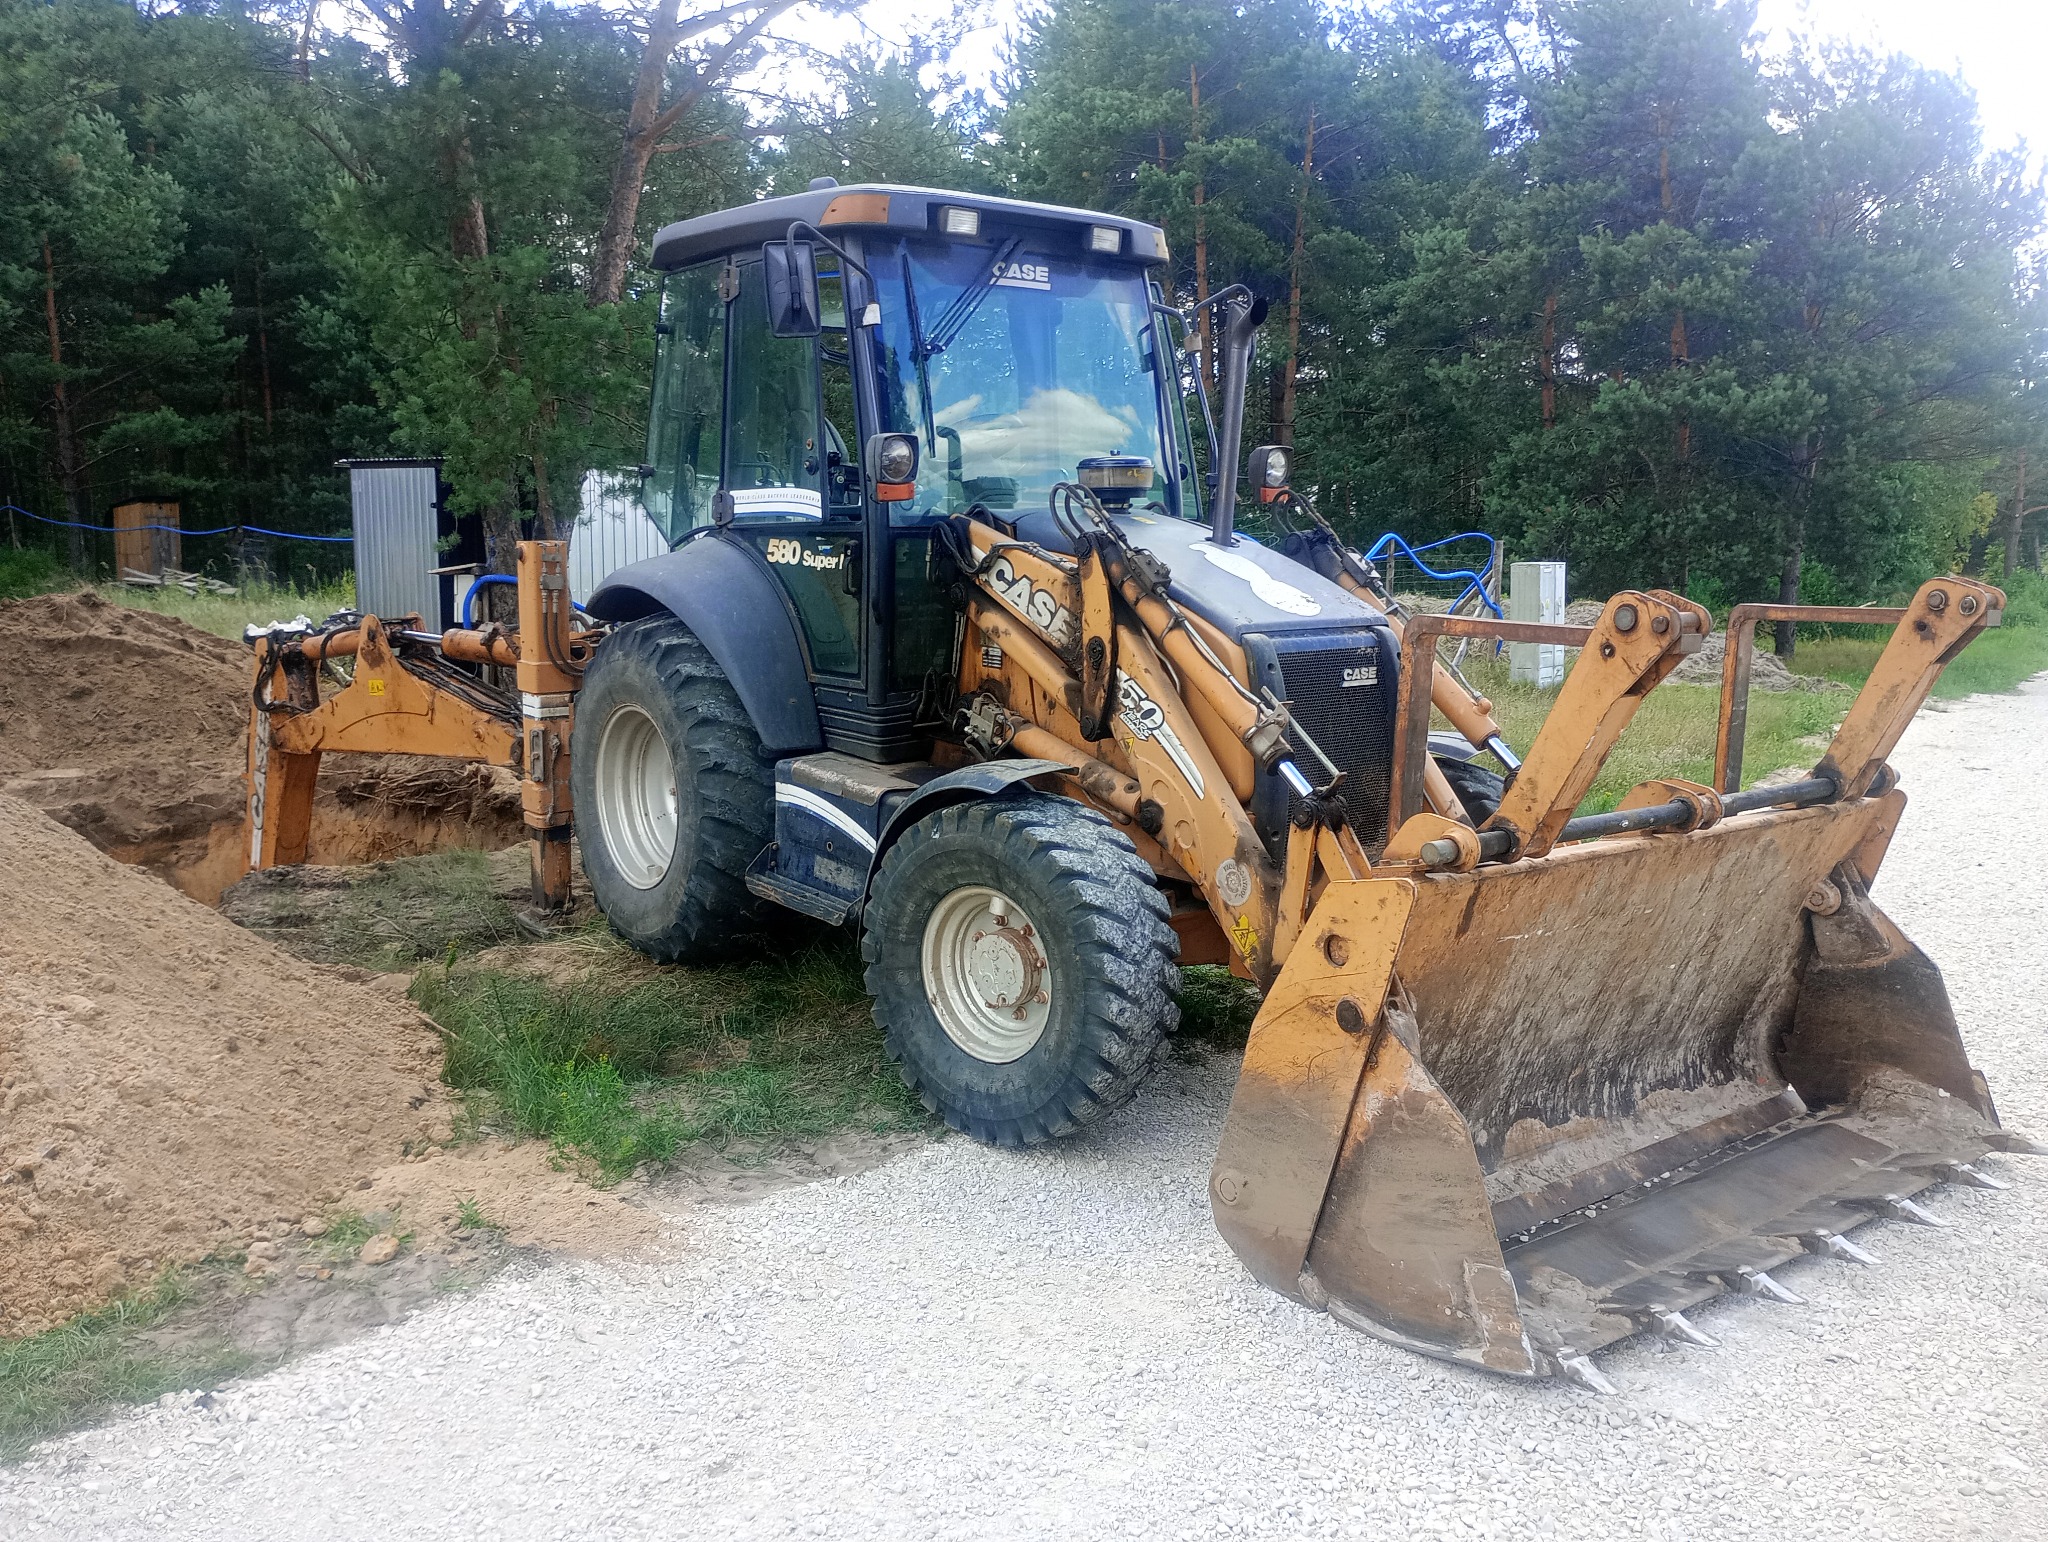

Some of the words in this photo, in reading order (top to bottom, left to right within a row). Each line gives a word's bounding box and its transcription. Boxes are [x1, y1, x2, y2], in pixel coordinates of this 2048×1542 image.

[992, 261, 1048, 282] CASE
[767, 538, 801, 566] 580
[802, 550, 838, 571] Super
[1343, 666, 1378, 681] CASE
[1124, 707, 1152, 737] YEARS
